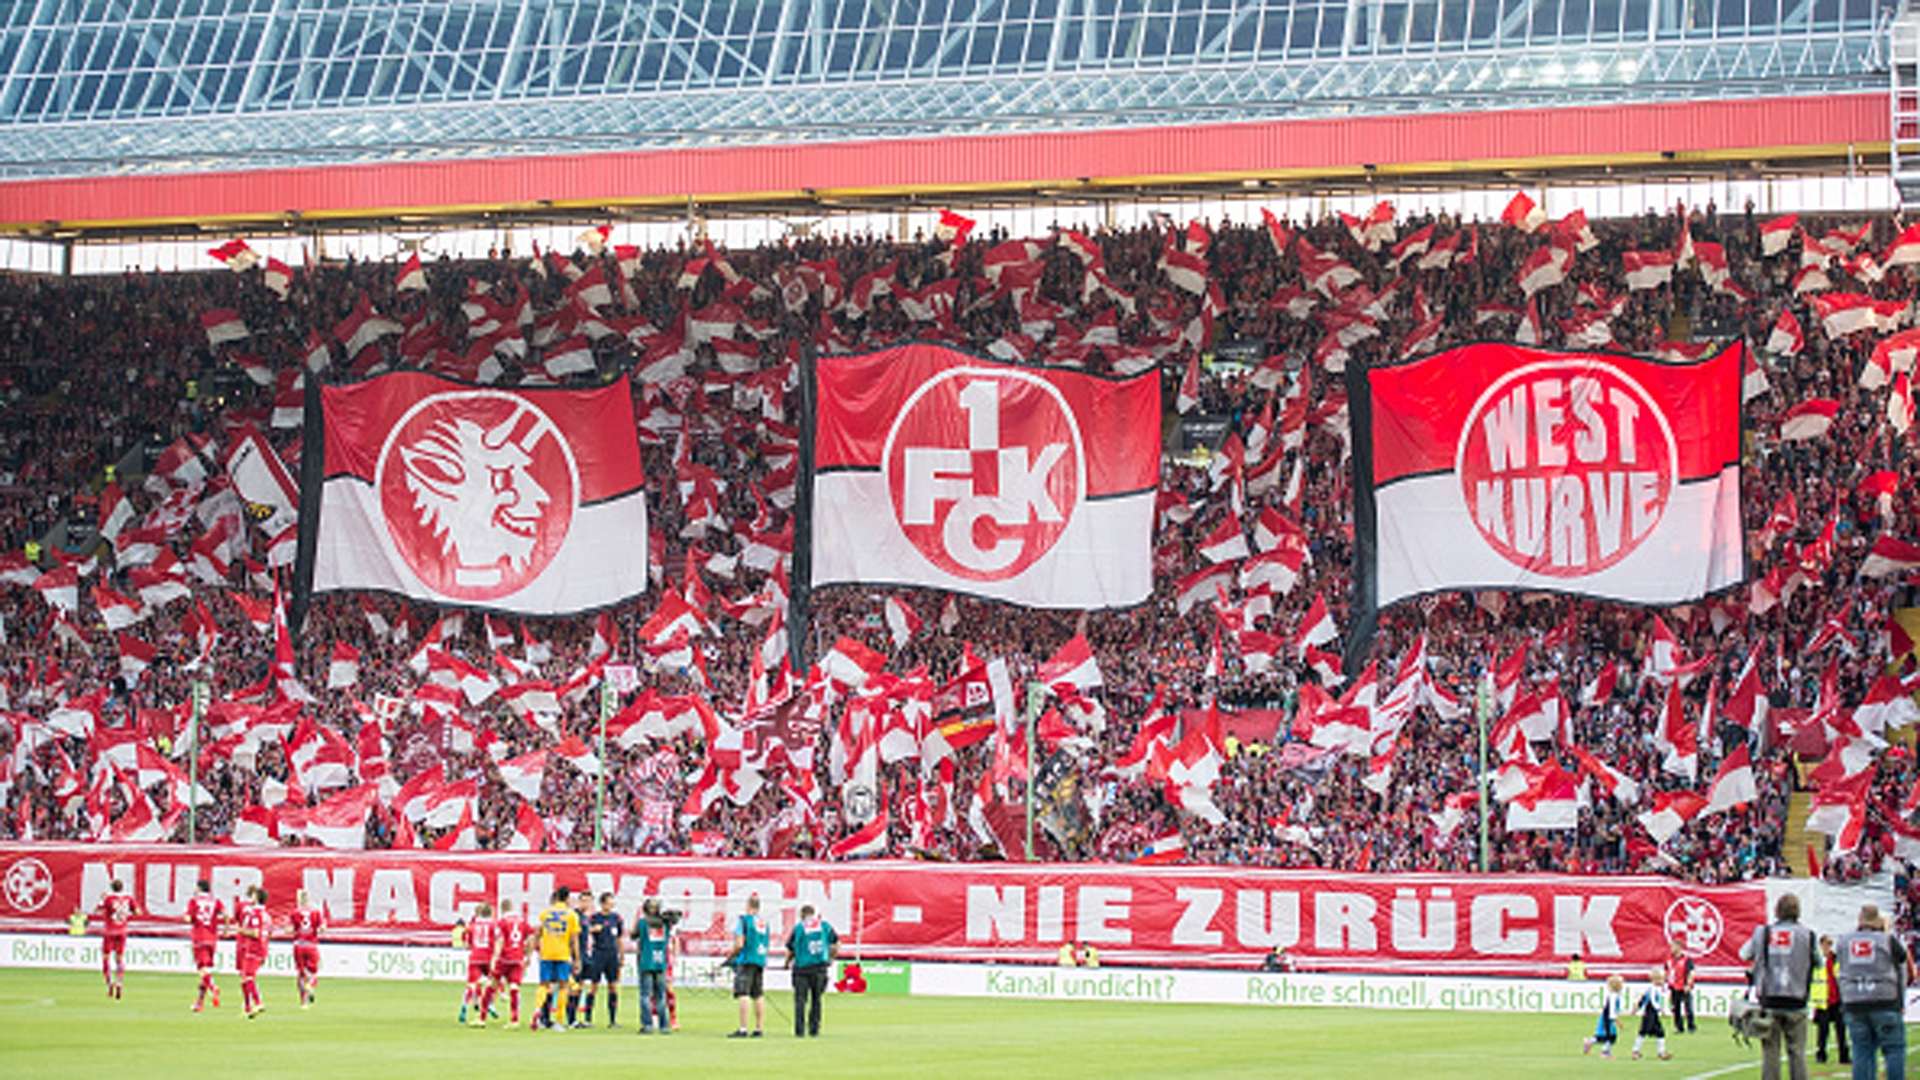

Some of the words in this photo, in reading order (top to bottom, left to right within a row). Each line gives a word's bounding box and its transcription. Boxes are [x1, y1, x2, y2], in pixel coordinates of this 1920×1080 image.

[1483, 376, 1640, 473] WEST
[1476, 472, 1660, 567] KURVE
[80, 862, 264, 920] NUR
[301, 867, 555, 926] NACH
[586, 872, 853, 936] VORN
[965, 885, 1133, 944] NIE
[1171, 887, 1623, 957] ZURÜCK
[510, 923, 522, 942] 6
[11, 940, 76, 962] Rohre
[367, 951, 415, 974] 50%
[986, 970, 1056, 994] Kanal
[1063, 974, 1176, 998] undicht?
[1247, 976, 1326, 1003] Rohre
[1331, 979, 1433, 1008] schnell,
[1440, 982, 1543, 1011] günstig
[1551, 986, 1604, 1010] und
